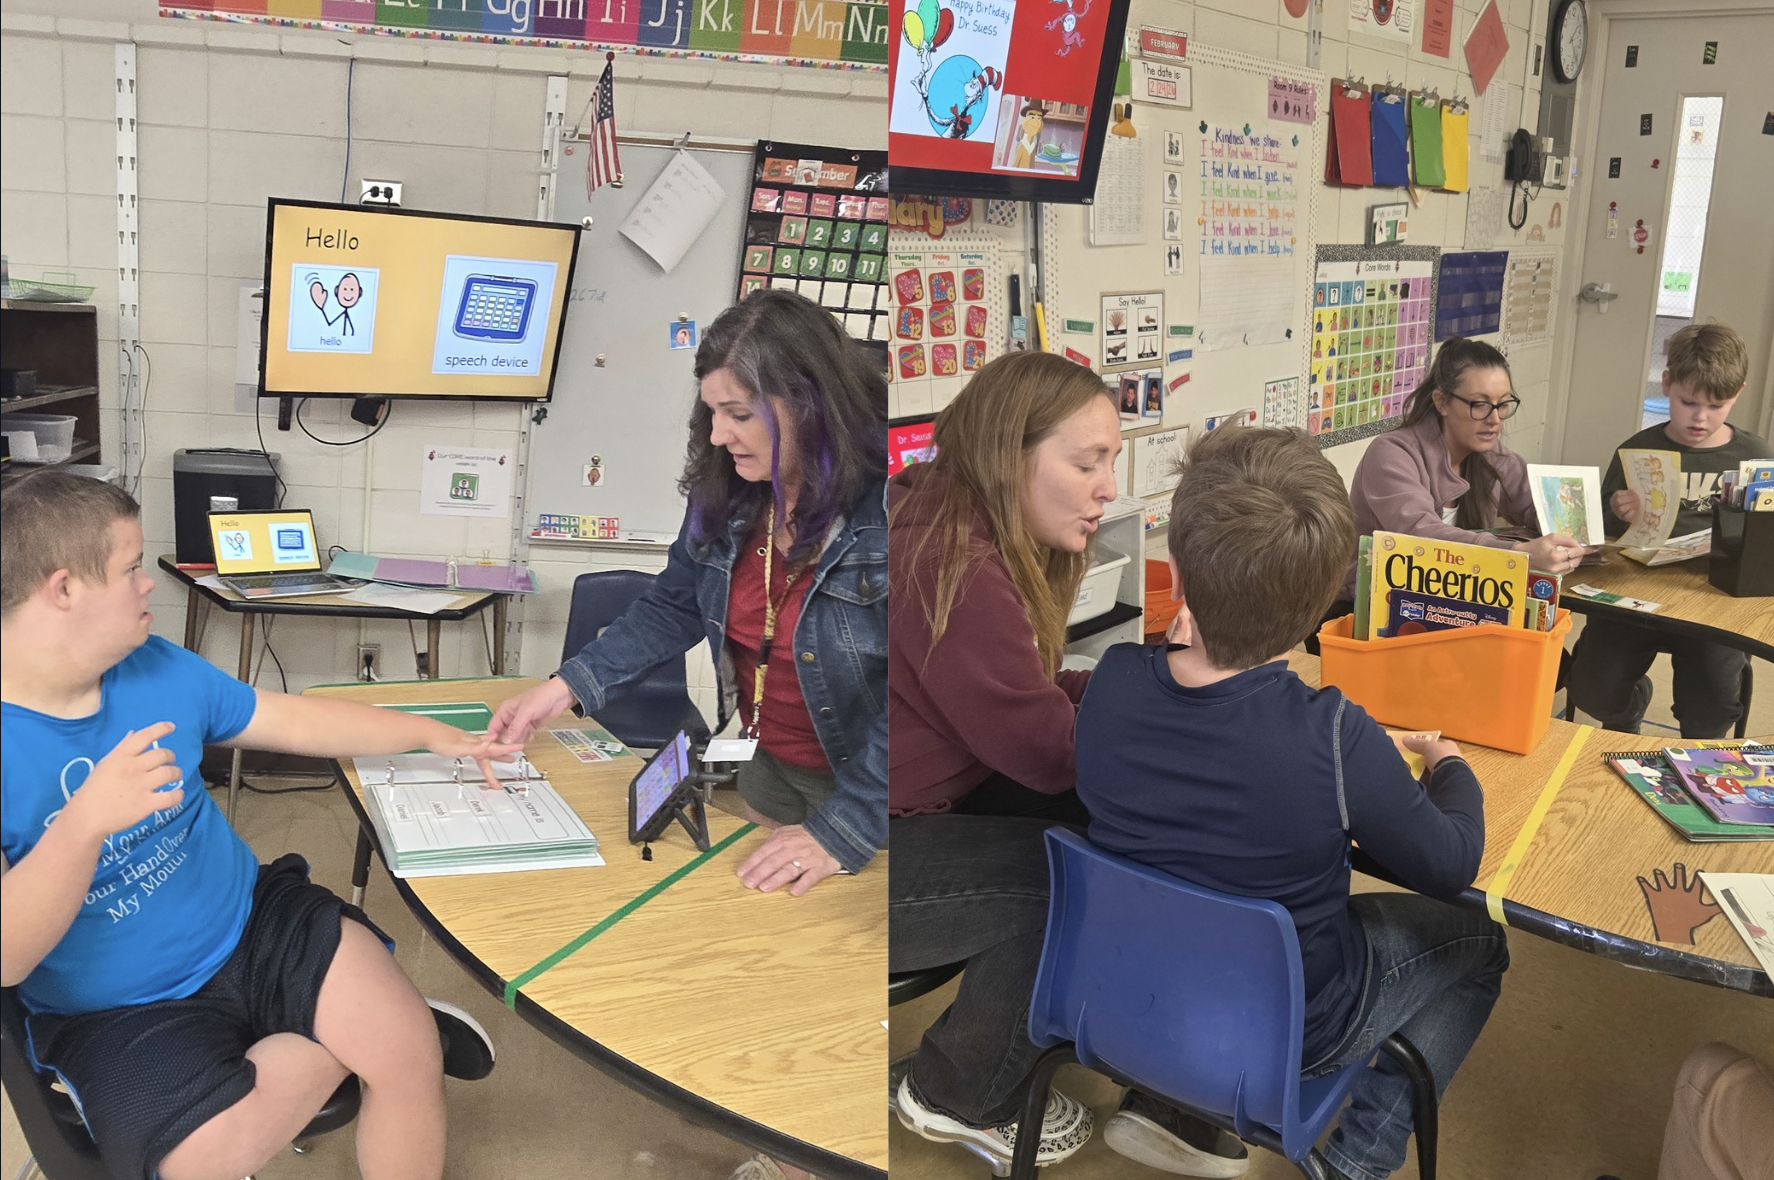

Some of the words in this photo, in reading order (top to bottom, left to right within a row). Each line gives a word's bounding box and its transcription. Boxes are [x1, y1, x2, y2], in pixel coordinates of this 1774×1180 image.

[976, 2, 1010, 24] Birthday
[648, 0, 684, 45] Jj
[700, 0, 734, 32] Kk
[751, 0, 783, 35] Ll
[792, 1, 844, 40] Mm
[958, 16, 972, 30] Dr.
[972, 24, 998, 36] Suess
[1151, 38, 1180, 50] FEBRUARY
[1142, 62, 1155, 75] The
[1158, 66, 1172, 78] date
[1274, 80, 1287, 90] Room
[1288, 84, 1292, 92] 9
[1216, 128, 1244, 144] Kindness
[1250, 136, 1260, 146] we
[1201, 140, 1207, 156] I
[1210, 141, 1224, 158] feel
[1240, 148, 1252, 159] when
[1255, 148, 1258, 160] I
[1201, 161, 1208, 177] I
[1212, 161, 1223, 178] feel
[1243, 165, 1256, 180] when
[1258, 166, 1262, 179] I
[1201, 181, 1207, 196] I
[1212, 181, 1222, 197] feel
[1243, 185, 1256, 198] when
[1259, 186, 1263, 198] I
[1201, 202, 1207, 216] I
[1212, 200, 1224, 218] feel
[1244, 204, 1257, 217] when
[1259, 203, 1264, 217] I
[790, 224, 796, 237] 1
[814, 227, 824, 240] 2
[1202, 221, 1207, 236] I
[1212, 221, 1224, 236] feel
[1245, 223, 1257, 236] when
[1260, 223, 1265, 236] I
[306, 227, 359, 250] Hello
[841, 230, 851, 243] 3
[868, 232, 878, 244] 4
[1200, 240, 1206, 254] I
[1211, 239, 1223, 254] feel
[1245, 240, 1258, 255] when
[1260, 240, 1265, 253] I
[754, 253, 762, 266] 7
[782, 255, 791, 268] 8
[809, 256, 818, 270] 9
[895, 254, 921, 263] Thursday
[932, 254, 950, 262] Friday
[832, 259, 846, 272] 10
[862, 260, 875, 274] 11
[1365, 264, 1376, 272] Core
[1377, 262, 1391, 271] Words
[914, 284, 923, 299] 5
[947, 286, 956, 301] 6
[1119, 297, 1129, 306] Say
[910, 324, 922, 338] 12
[942, 320, 955, 334] 13
[975, 322, 984, 336] 14
[320, 337, 342, 347] hello
[445, 354, 487, 368] speech
[492, 355, 528, 368] device
[912, 360, 925, 374] 19
[942, 359, 956, 373] 20
[973, 356, 983, 369] 21
[897, 434, 910, 445] Dr.
[1148, 436, 1154, 446] At
[1157, 432, 1177, 444] school
[1434, 548, 1464, 566] The
[1385, 554, 1514, 608] Cheerios
[1426, 612, 1476, 626] Adventure
[396, 804, 410, 819] Daniel
[432, 802, 446, 815] Jacob
[470, 801, 484, 812] Derek
[524, 802, 540, 817] name
[85, 882, 116, 904] our
[119, 844, 168, 885] Hand
[161, 828, 189, 852] Over
[107, 894, 140, 923] My
